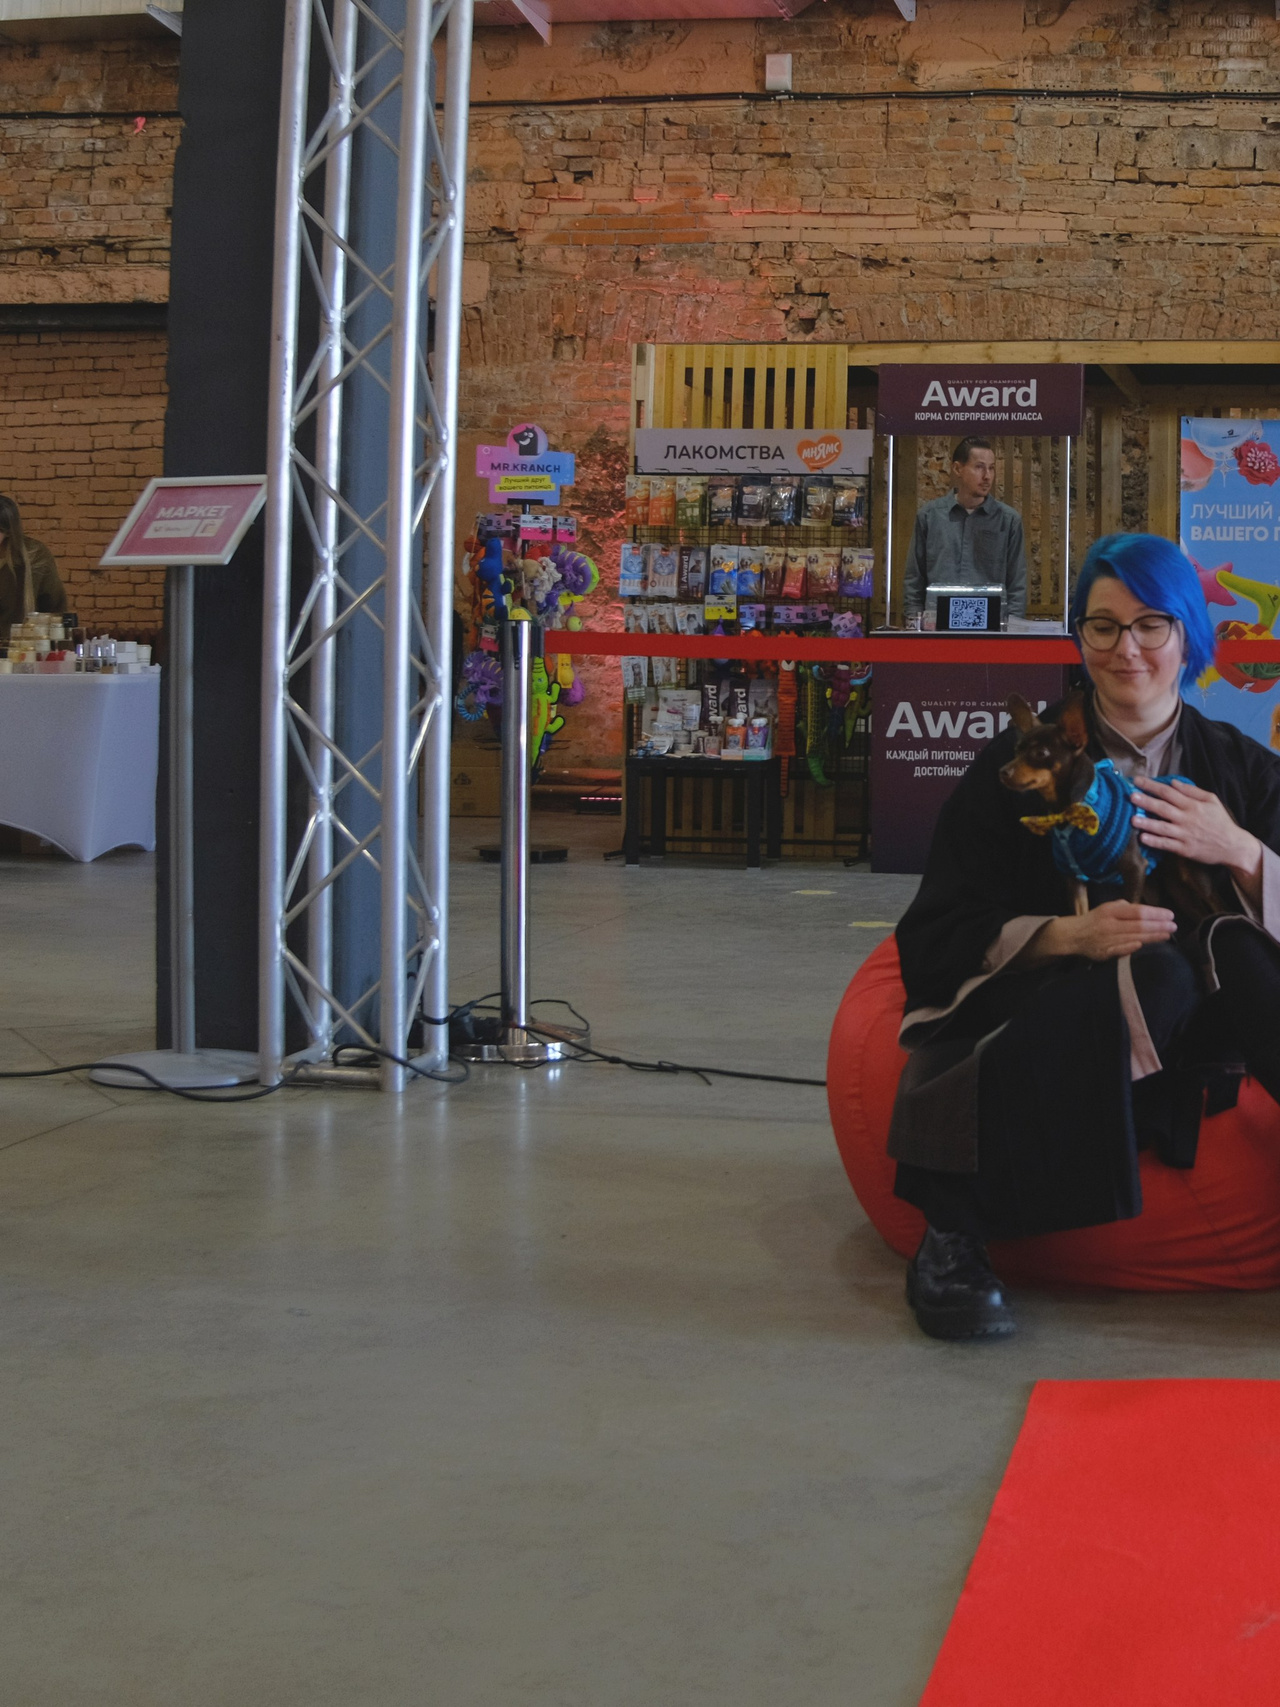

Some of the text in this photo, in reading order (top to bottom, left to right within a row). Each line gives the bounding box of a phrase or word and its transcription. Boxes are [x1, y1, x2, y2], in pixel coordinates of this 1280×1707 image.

[921, 378, 1037, 407] Award
[914, 412, 1043, 421] КОРМА СУПЕРПРЕМИУМ КЛАССА
[664, 445, 785, 460] ЛАКОМСТВА
[490, 462, 561, 473] MR.KRANCH
[156, 505, 232, 519] МАРКЕТ
[1190, 501, 1273, 520] ЛУЧШИЙ
[1190, 526, 1270, 542] ВАШЕГО
[704, 684, 718, 719] ward
[886, 748, 929, 761] КАЖДЫЙ
